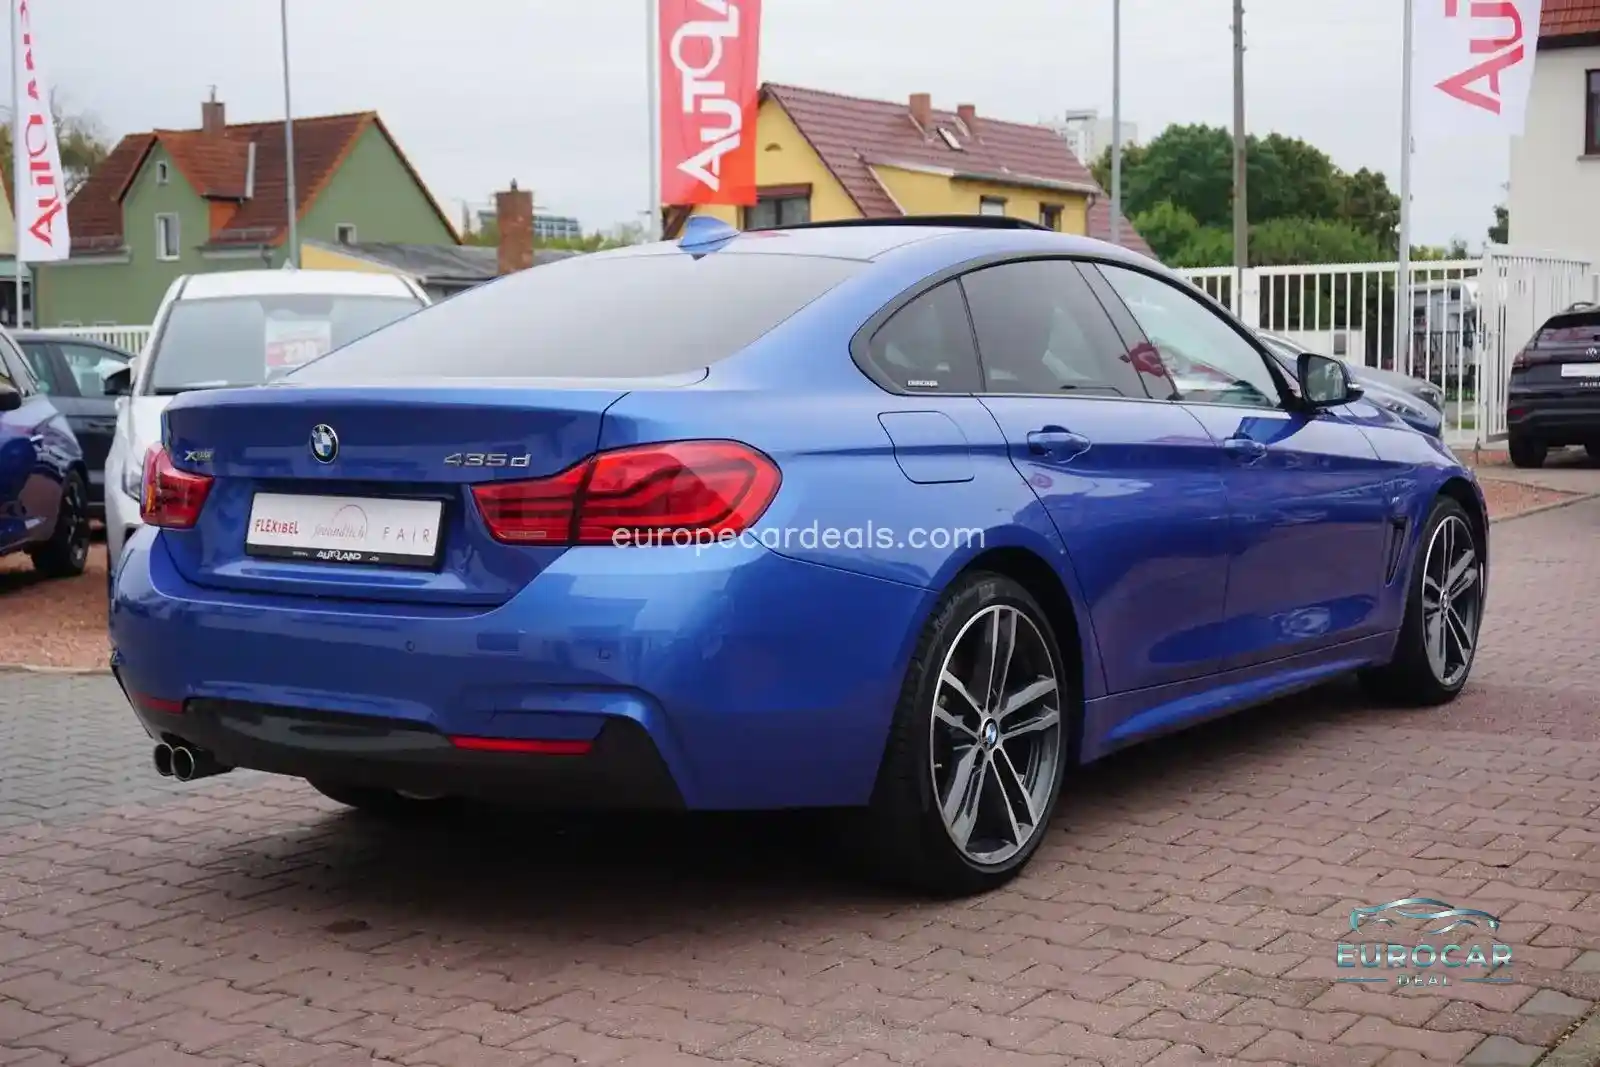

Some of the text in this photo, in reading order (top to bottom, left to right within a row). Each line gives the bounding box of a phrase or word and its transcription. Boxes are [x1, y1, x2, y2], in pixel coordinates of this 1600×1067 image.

[254, 518, 299, 535] FLEXIBEL
[382, 526, 431, 541] FAIR
[316, 549, 362, 561] AUTOLAND
